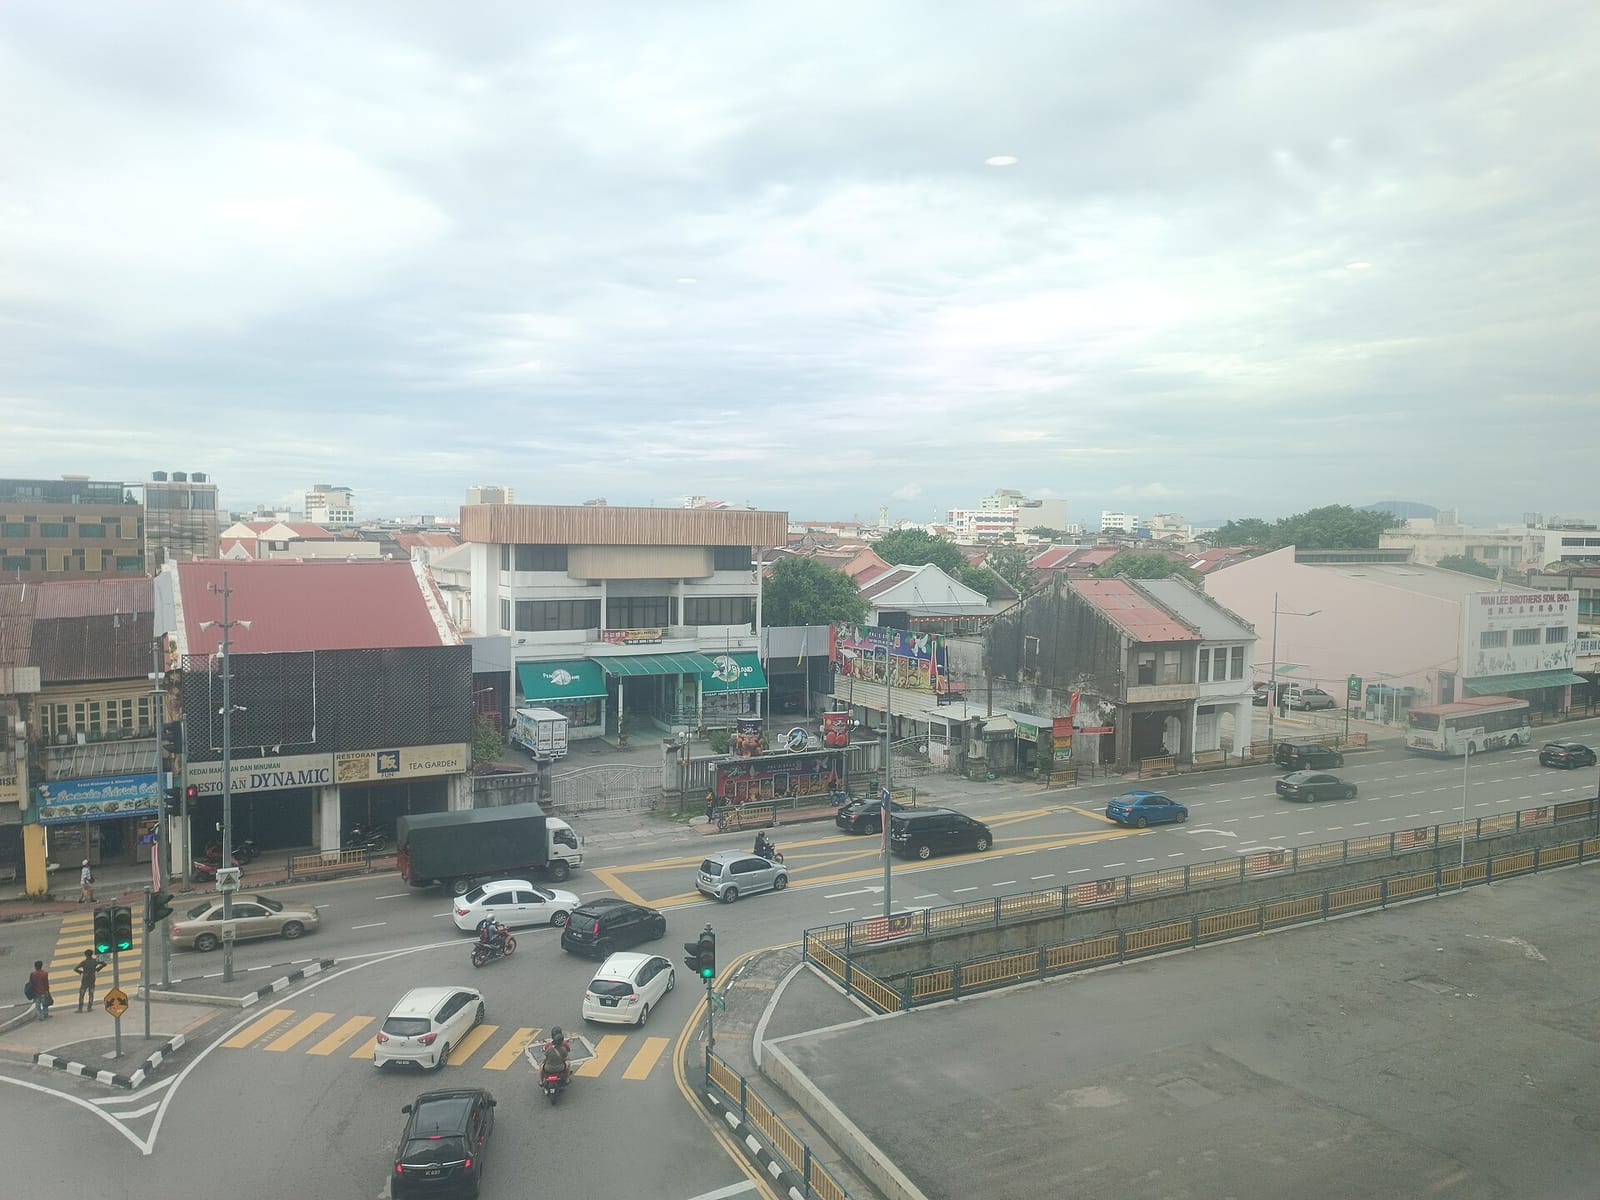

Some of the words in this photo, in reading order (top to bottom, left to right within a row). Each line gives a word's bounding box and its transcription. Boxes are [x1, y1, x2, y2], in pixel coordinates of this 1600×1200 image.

[1497, 595, 1509, 605] LEE
[1510, 594, 1542, 605] BROTHERS
[336, 752, 376, 760] RESTORAN
[425, 760, 457, 769] GARDEN
[189, 768, 208, 776] KEDAI
[209, 766, 239, 775] MAKAN
[250, 768, 330, 789] DYNAMIC
